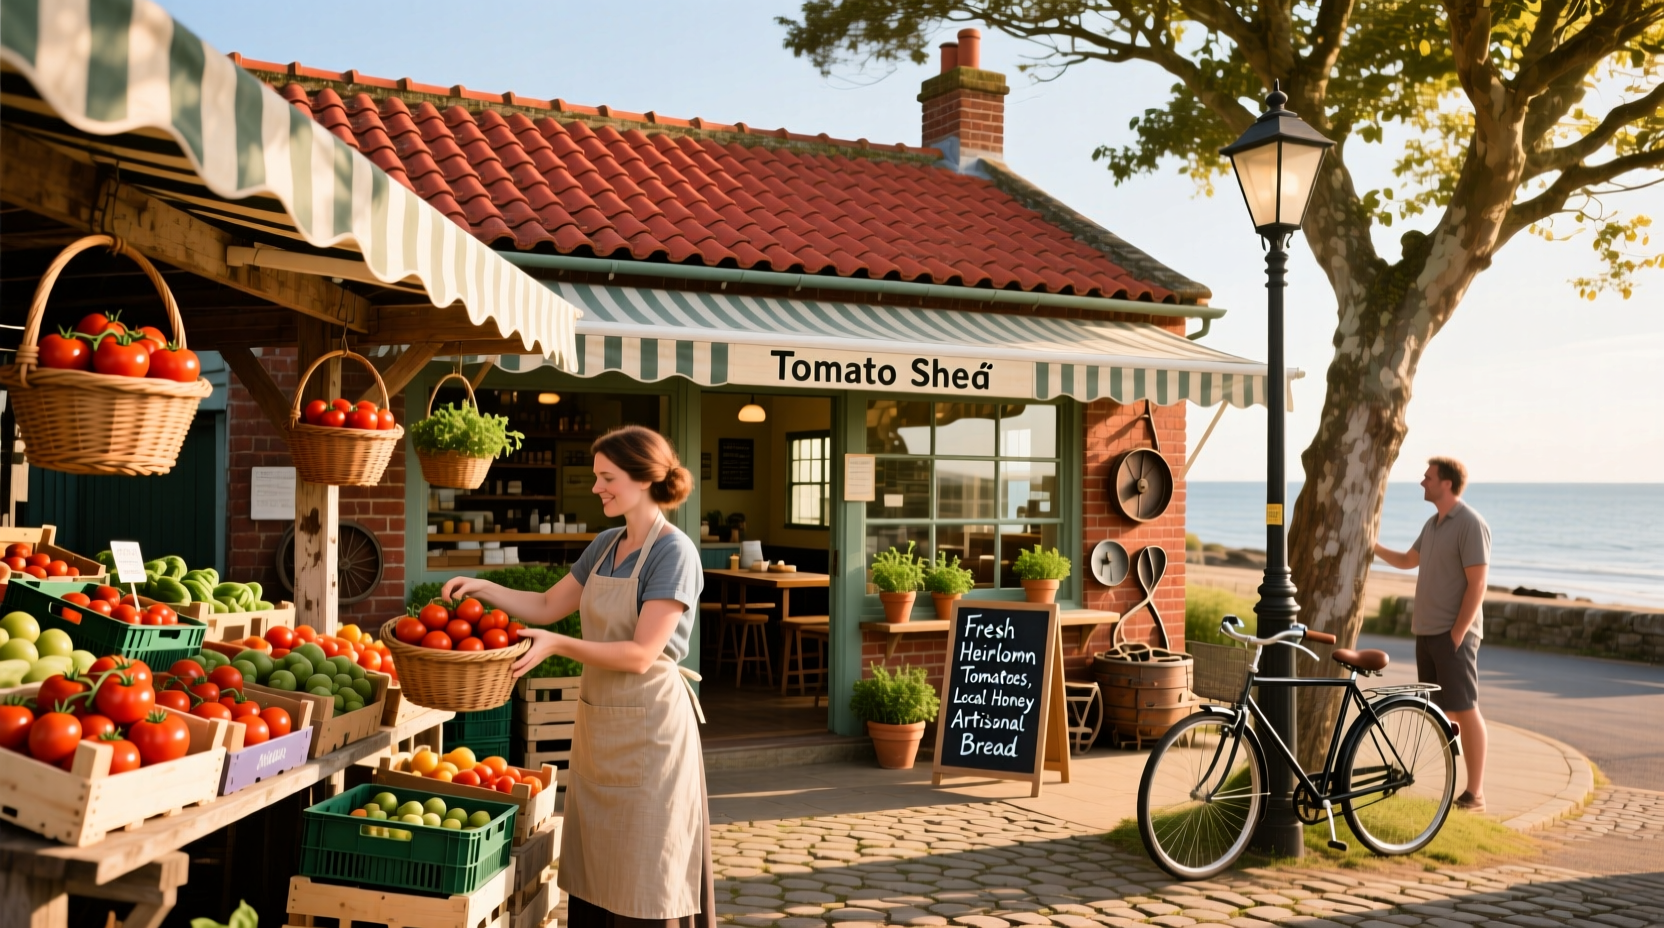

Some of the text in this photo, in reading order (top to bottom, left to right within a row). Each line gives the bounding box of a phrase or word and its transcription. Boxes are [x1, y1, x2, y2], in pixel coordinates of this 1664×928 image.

[771, 350, 896, 386] Tomato
[965, 614, 1015, 640] Fresh
[953, 687, 1034, 715] Local Honey
[960, 732, 1018, 758] Bread
